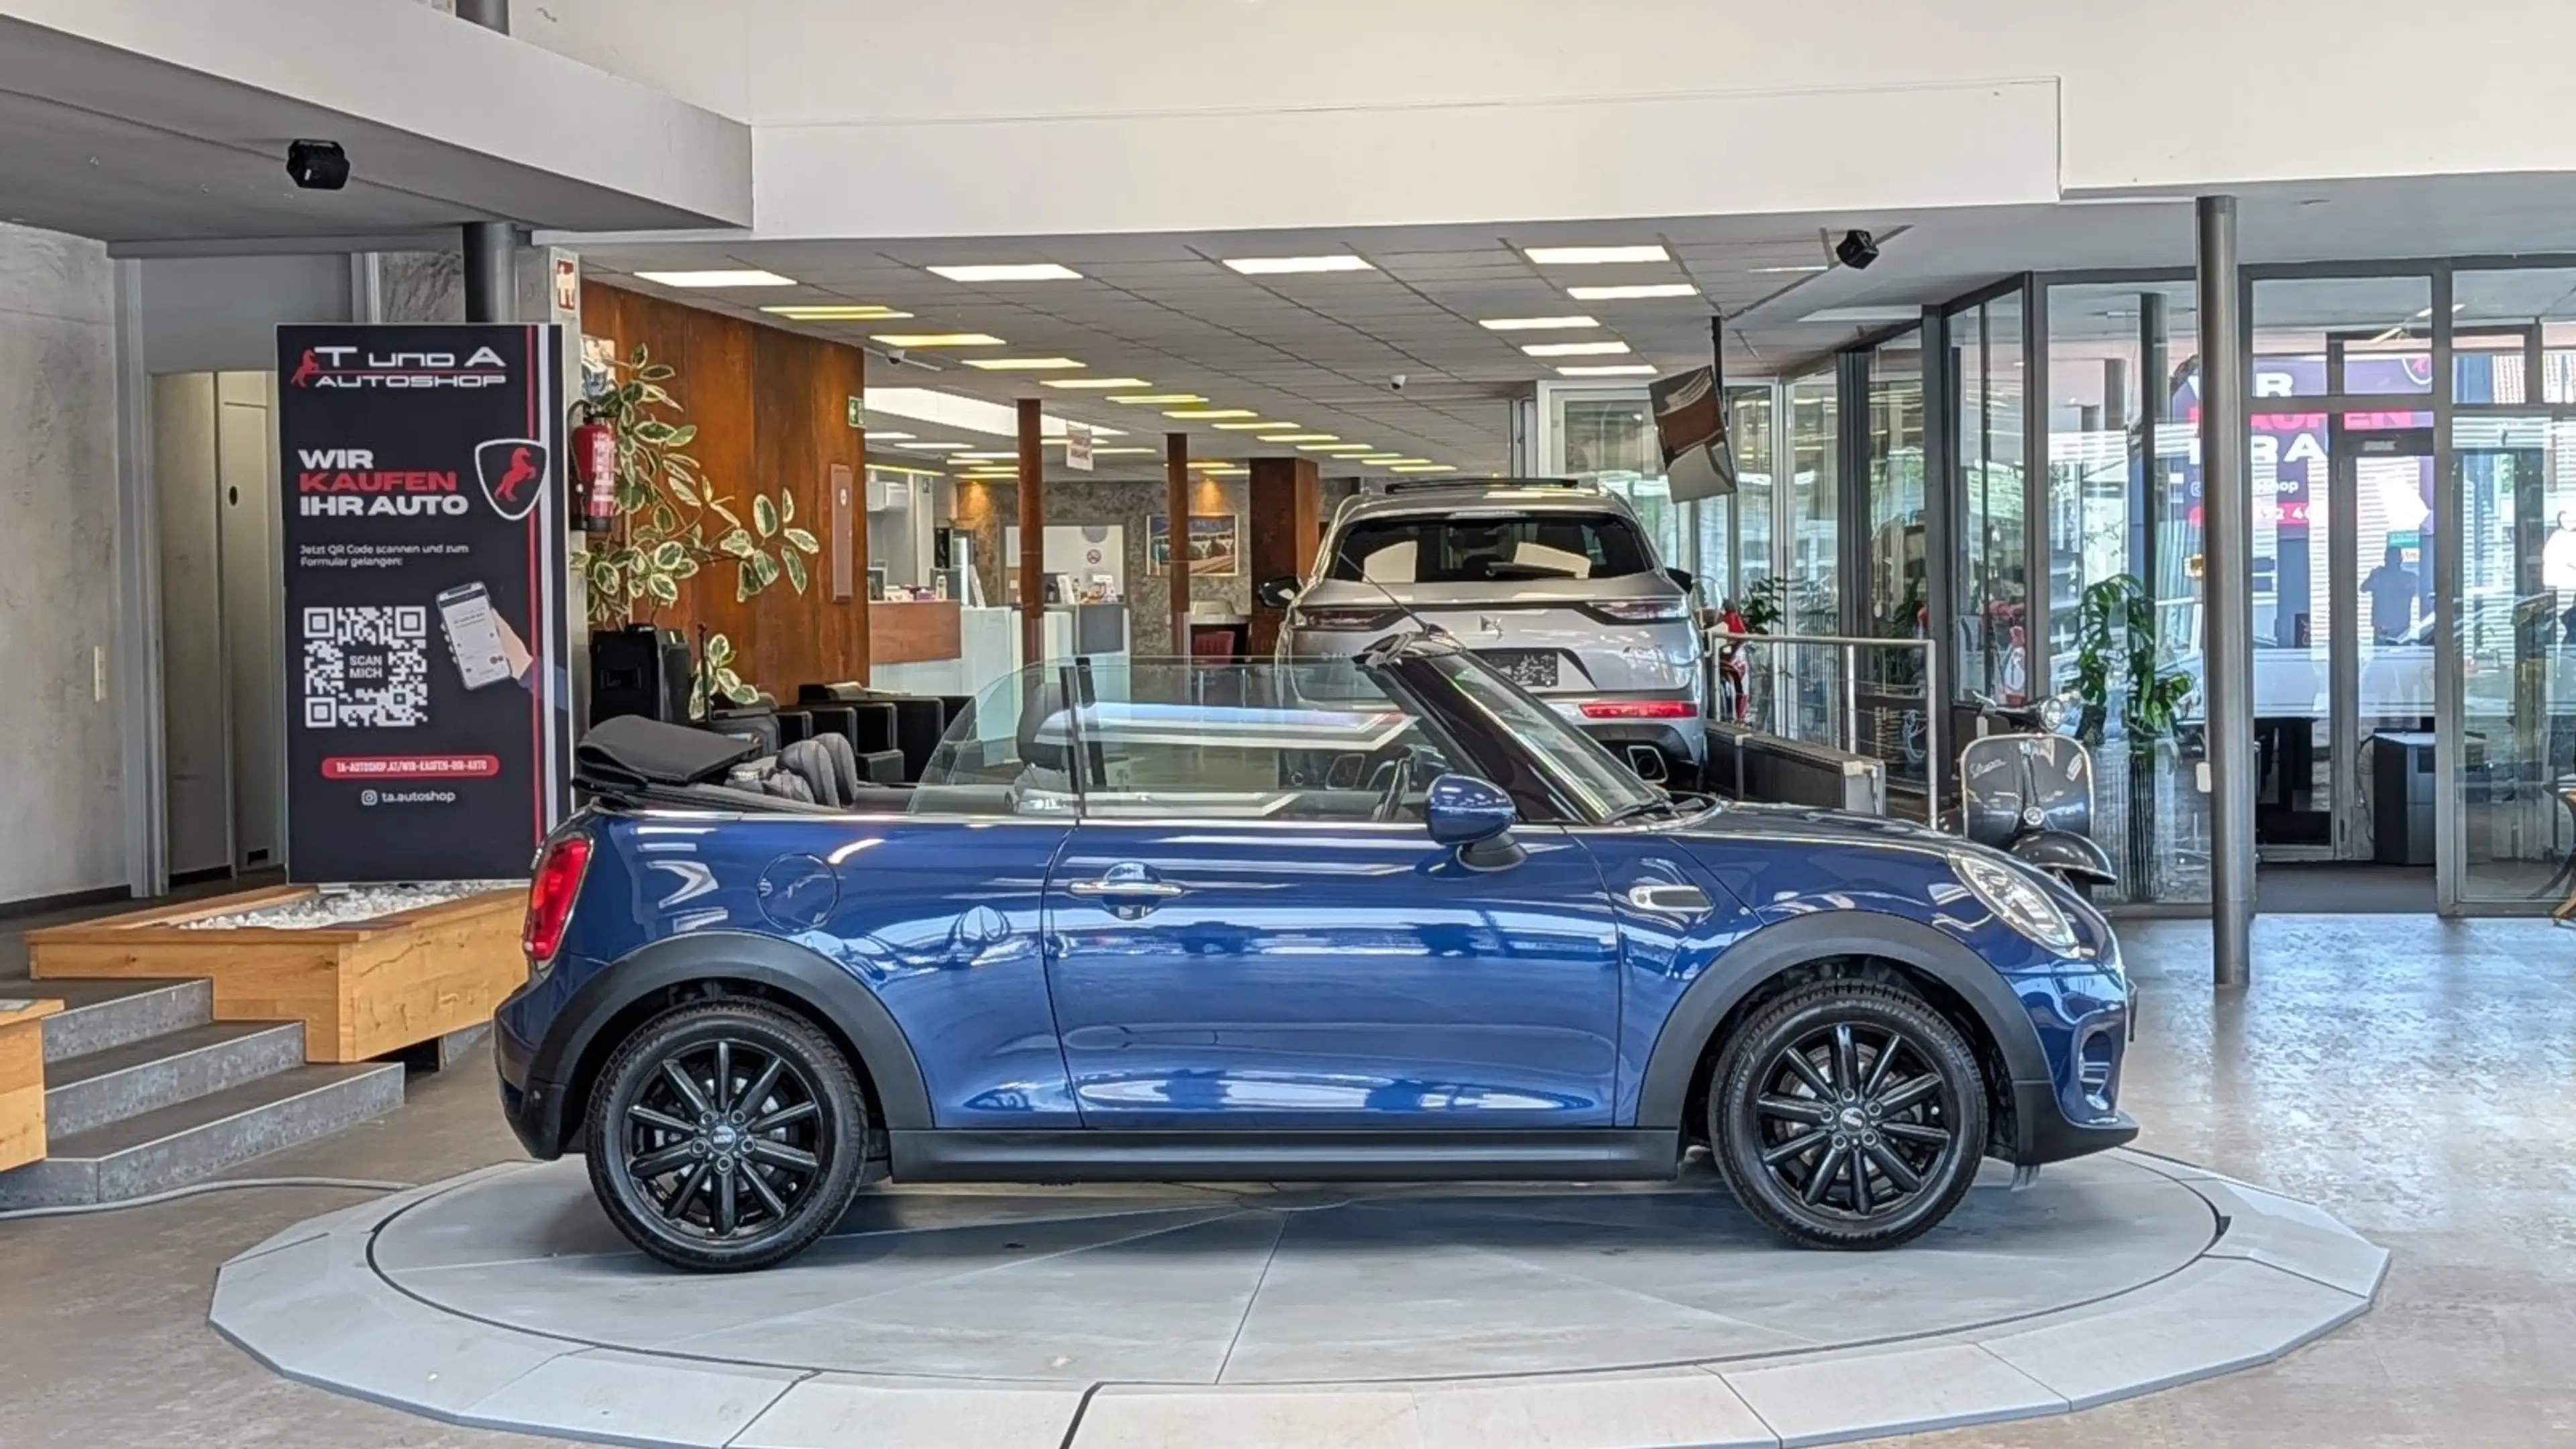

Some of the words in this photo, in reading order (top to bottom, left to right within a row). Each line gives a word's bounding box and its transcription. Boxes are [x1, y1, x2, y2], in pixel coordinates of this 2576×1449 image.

[314, 346, 358, 367] T
[464, 346, 506, 367] A
[315, 375, 506, 388] AUTOSHOP
[298, 449, 374, 470] WIR
[300, 472, 457, 492] KAUFEN
[301, 495, 364, 516] IHR
[368, 494, 469, 516] AUTO
[300, 544, 325, 555] Jetzt
[327, 544, 345, 555] QR
[346, 544, 374, 555] Code
[375, 545, 421, 555] scannen
[421, 544, 444, 554] und
[445, 545, 470, 553] zum
[300, 556, 349, 567] Formular
[349, 655, 382, 666] SCAN
[349, 667, 383, 679] MICH
[381, 790, 456, 804] ta.autoshop
